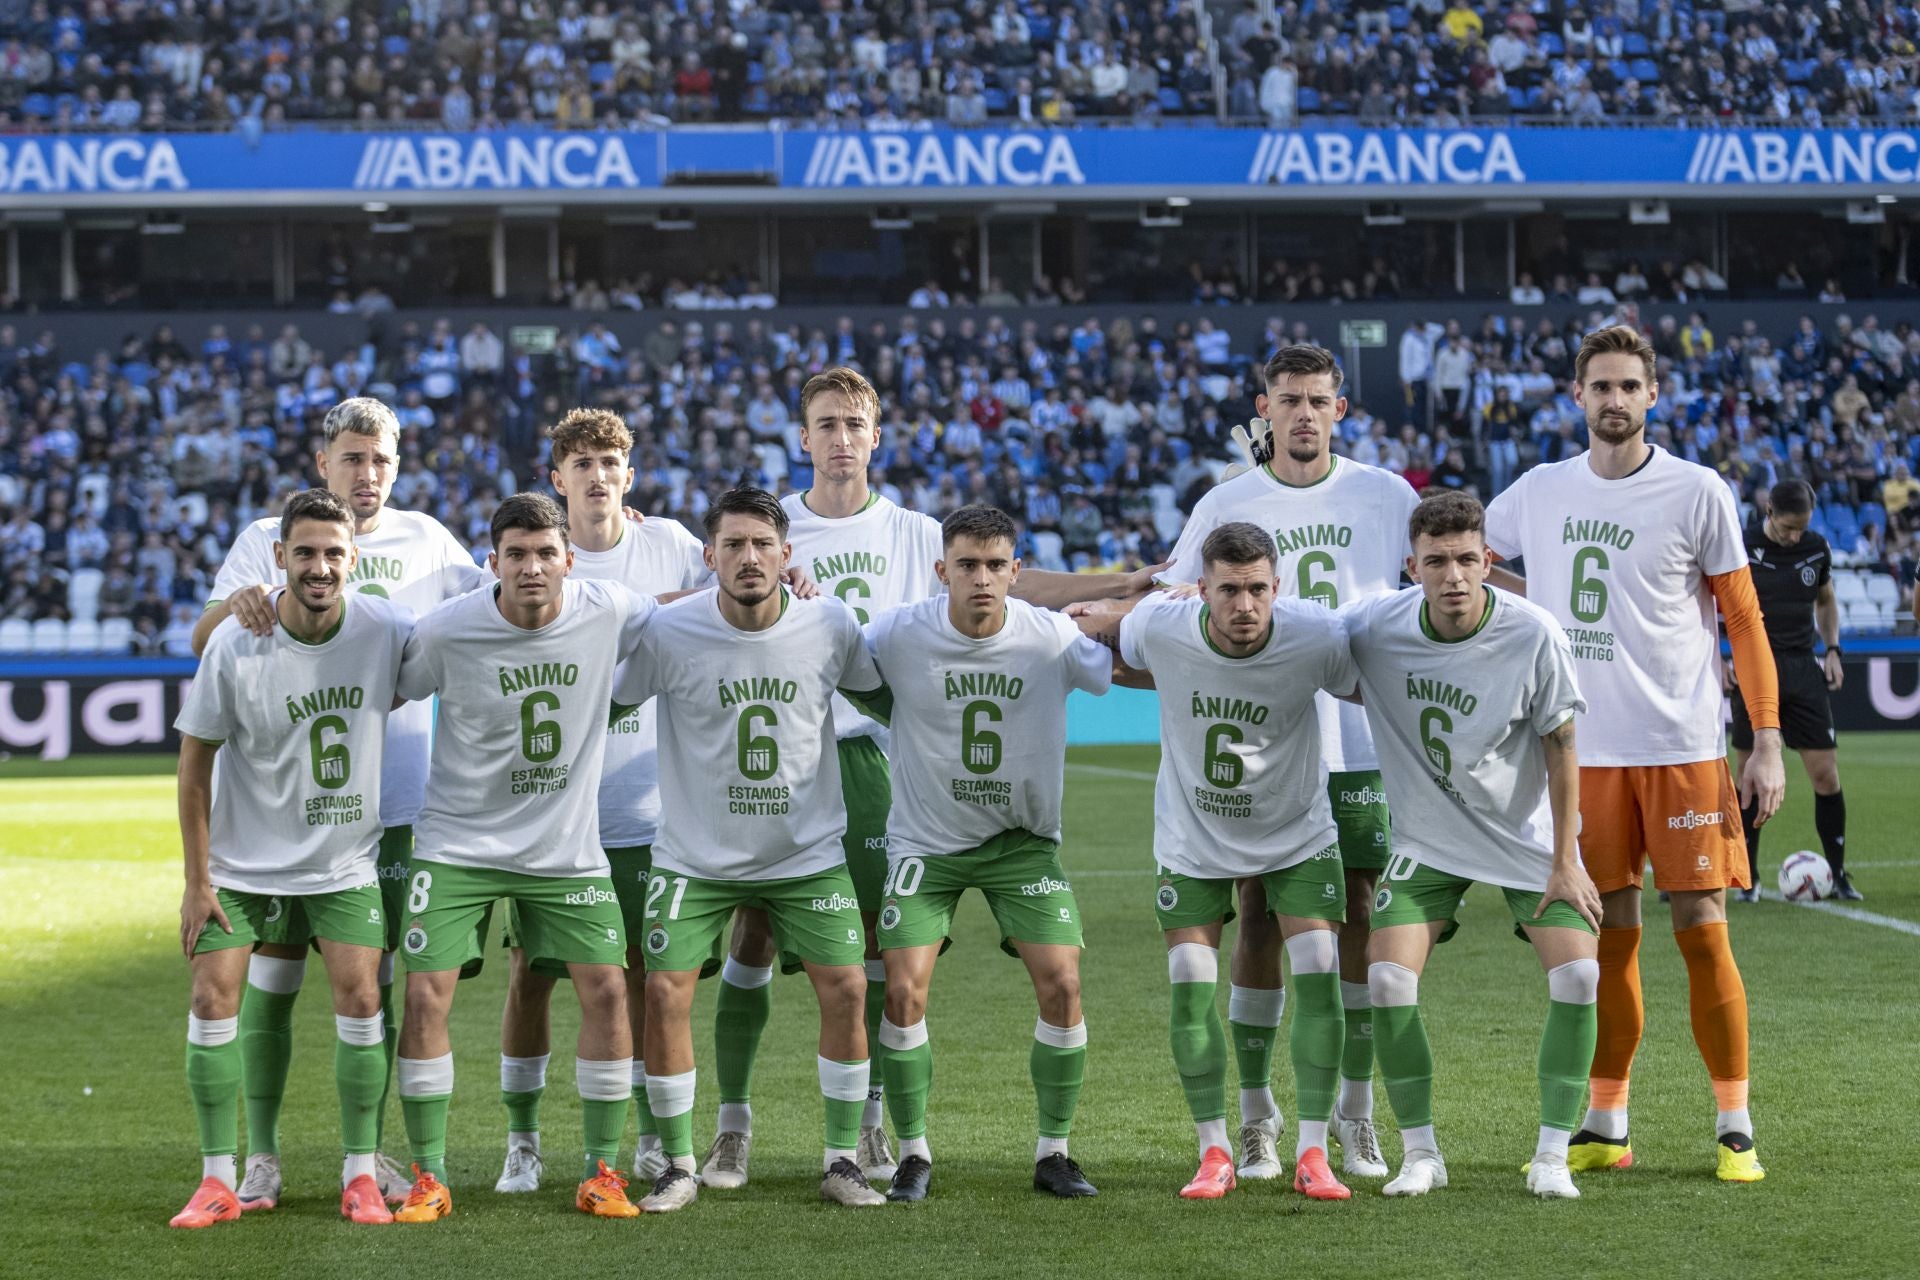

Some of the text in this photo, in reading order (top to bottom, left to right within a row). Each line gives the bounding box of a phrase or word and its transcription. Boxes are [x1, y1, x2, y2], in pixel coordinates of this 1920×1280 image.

[384, 136, 639, 188] ABANCA
[833, 134, 1085, 185] ABANCA
[1278, 133, 1525, 184] ABANCA
[1714, 133, 1920, 184] ABANC
[1275, 524, 1353, 557] ÁNIMO
[1562, 516, 1635, 551] ÁNIMO
[813, 551, 887, 584] ÁNIMO
[1297, 550, 1338, 610] 6
[1570, 545, 1610, 624] 6
[1562, 628, 1614, 646] STAMOS
[499, 662, 579, 697] ÁNIMO
[718, 677, 798, 709] ÁNIMO
[944, 671, 1024, 701] ÁNIMO
[1406, 672, 1478, 717] ÁNIMO
[286, 686, 365, 724] ÁNIMO
[1191, 690, 1269, 726] ÁNIMO
[520, 690, 562, 763] 6
[737, 704, 779, 782] 6
[961, 699, 1003, 775] 6
[1420, 706, 1453, 777] 6
[310, 714, 351, 789] 6
[1204, 723, 1244, 789] 6
[511, 764, 569, 782] ESTAMOS
[511, 778, 567, 795] CONTIGO
[952, 778, 1012, 794] ESTAMOS
[305, 794, 362, 811] ESTAMOS
[728, 786, 790, 800] ESTAMOS
[729, 801, 789, 816] CONTIGO
[953, 791, 1011, 806] CONTIGO
[1195, 786, 1253, 806] ESTAMOS
[1196, 799, 1251, 818] CONTIGO
[307, 809, 363, 826] CONTIGO
[408, 870, 432, 913] 8
[645, 875, 689, 920] 21
